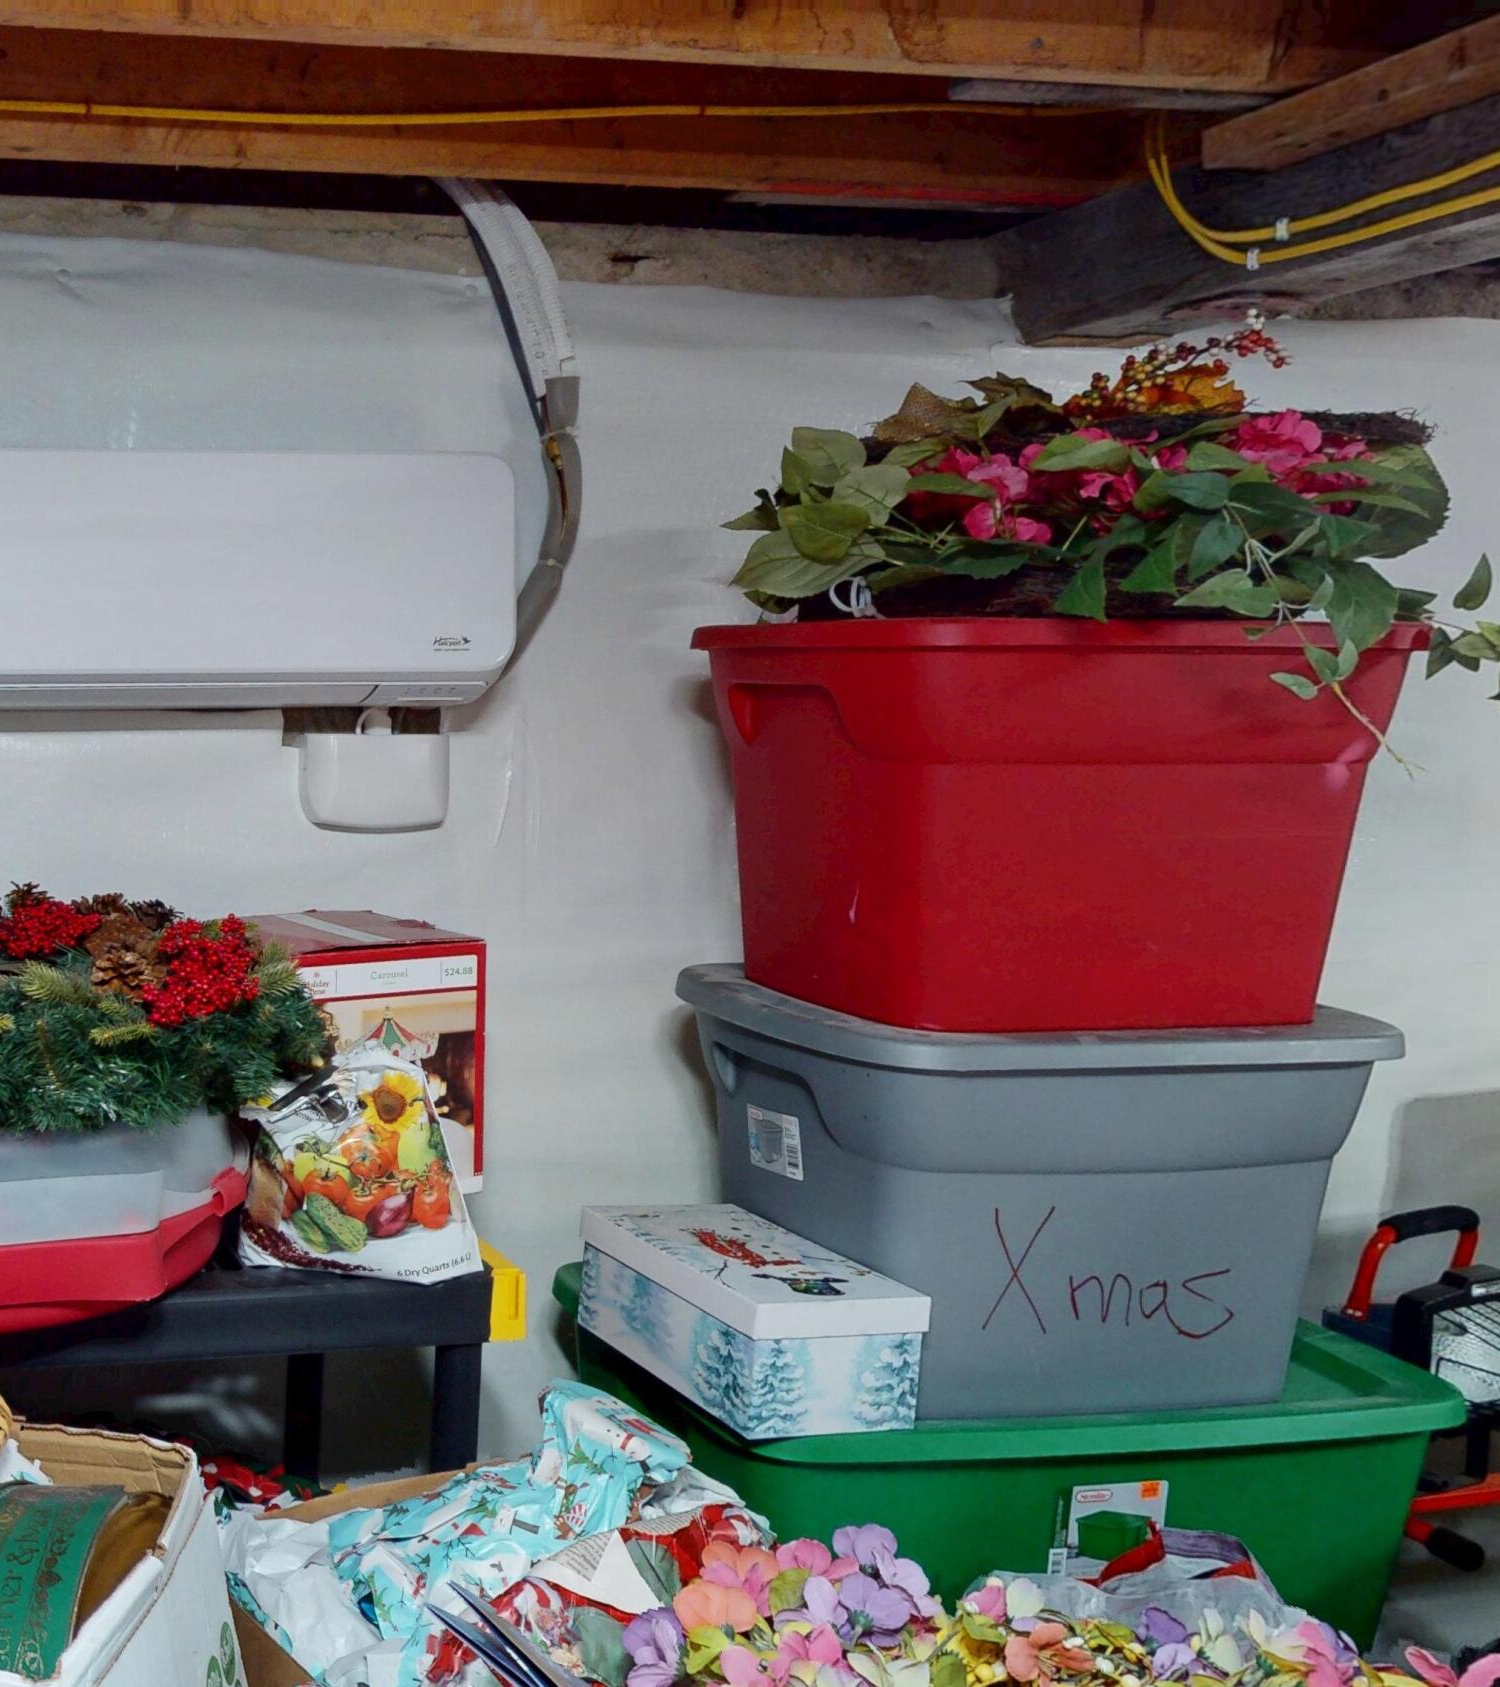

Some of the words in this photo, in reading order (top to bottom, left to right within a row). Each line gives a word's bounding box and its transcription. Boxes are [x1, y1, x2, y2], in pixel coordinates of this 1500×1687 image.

[370, 967, 409, 980] Carousel
[404, 1268, 420, 1278] Dry
[421, 1261, 450, 1275] Quarts
[981, 1205, 1234, 1339] Xmas
